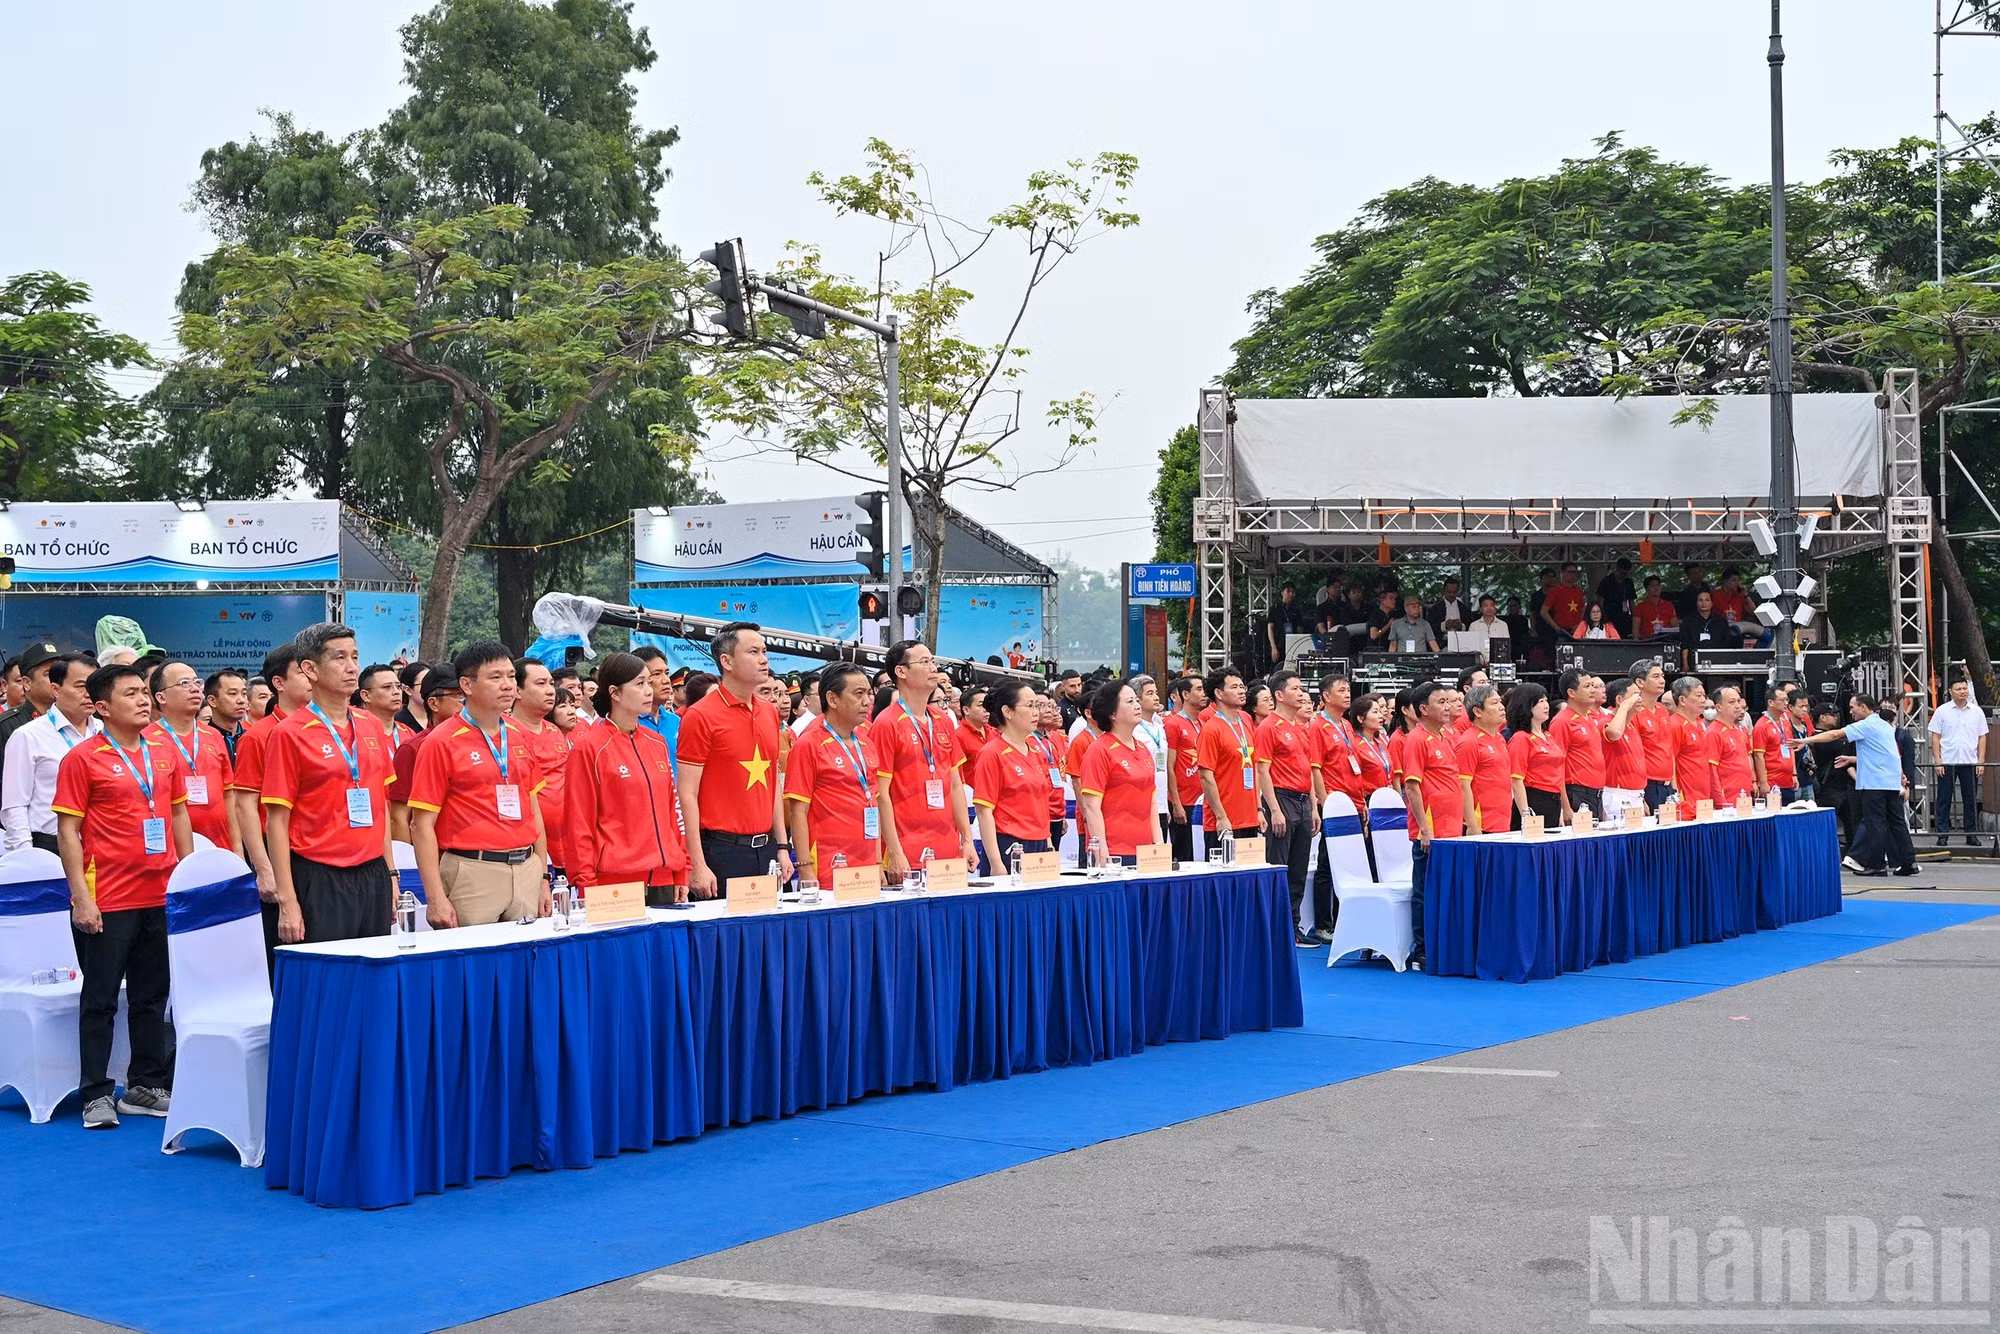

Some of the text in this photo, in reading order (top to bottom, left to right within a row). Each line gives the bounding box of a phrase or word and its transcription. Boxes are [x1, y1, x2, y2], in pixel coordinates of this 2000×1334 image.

[4, 538, 110, 556] BAN TỔ CHỨC
[190, 537, 298, 555] BAN TỔ CHỨC
[810, 534, 835, 552] HẬU
[674, 541, 697, 558] HẬU
[1160, 566, 1180, 576] PHỐ
[1170, 578, 1192, 592] HOÀNG
[734, 603, 747, 611] VTV
[239, 612, 257, 621] VTV
[673, 643, 694, 652] PHONG
[182, 649, 204, 659] TRÀO
[204, 649, 229, 659] TOÀN
